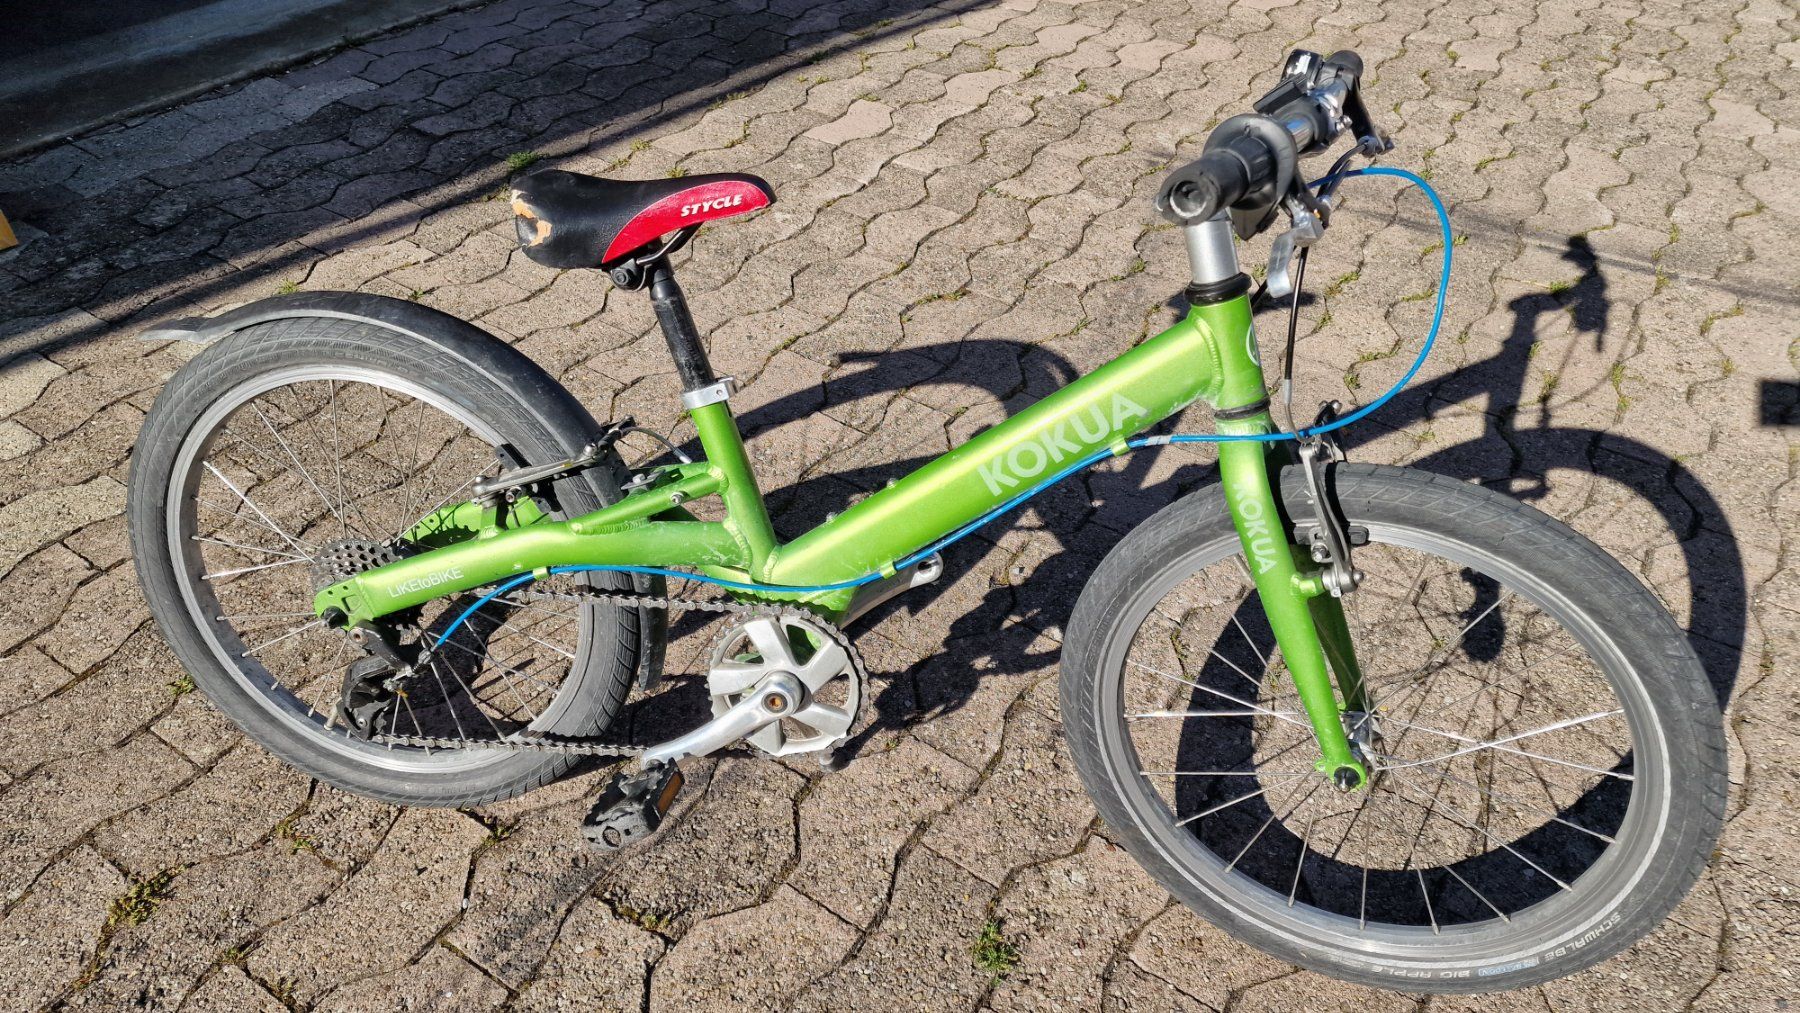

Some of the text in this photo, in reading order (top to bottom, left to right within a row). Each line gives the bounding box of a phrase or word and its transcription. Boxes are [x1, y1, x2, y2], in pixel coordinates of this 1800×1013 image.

[680, 194, 743, 217] STYCLE
[976, 392, 1148, 497] KOKUA
[1232, 483, 1278, 575] KOKUA
[387, 566, 465, 598] LIKEtoBIKE
[1371, 911, 1622, 979] SCHWALBE BIG APPLE
